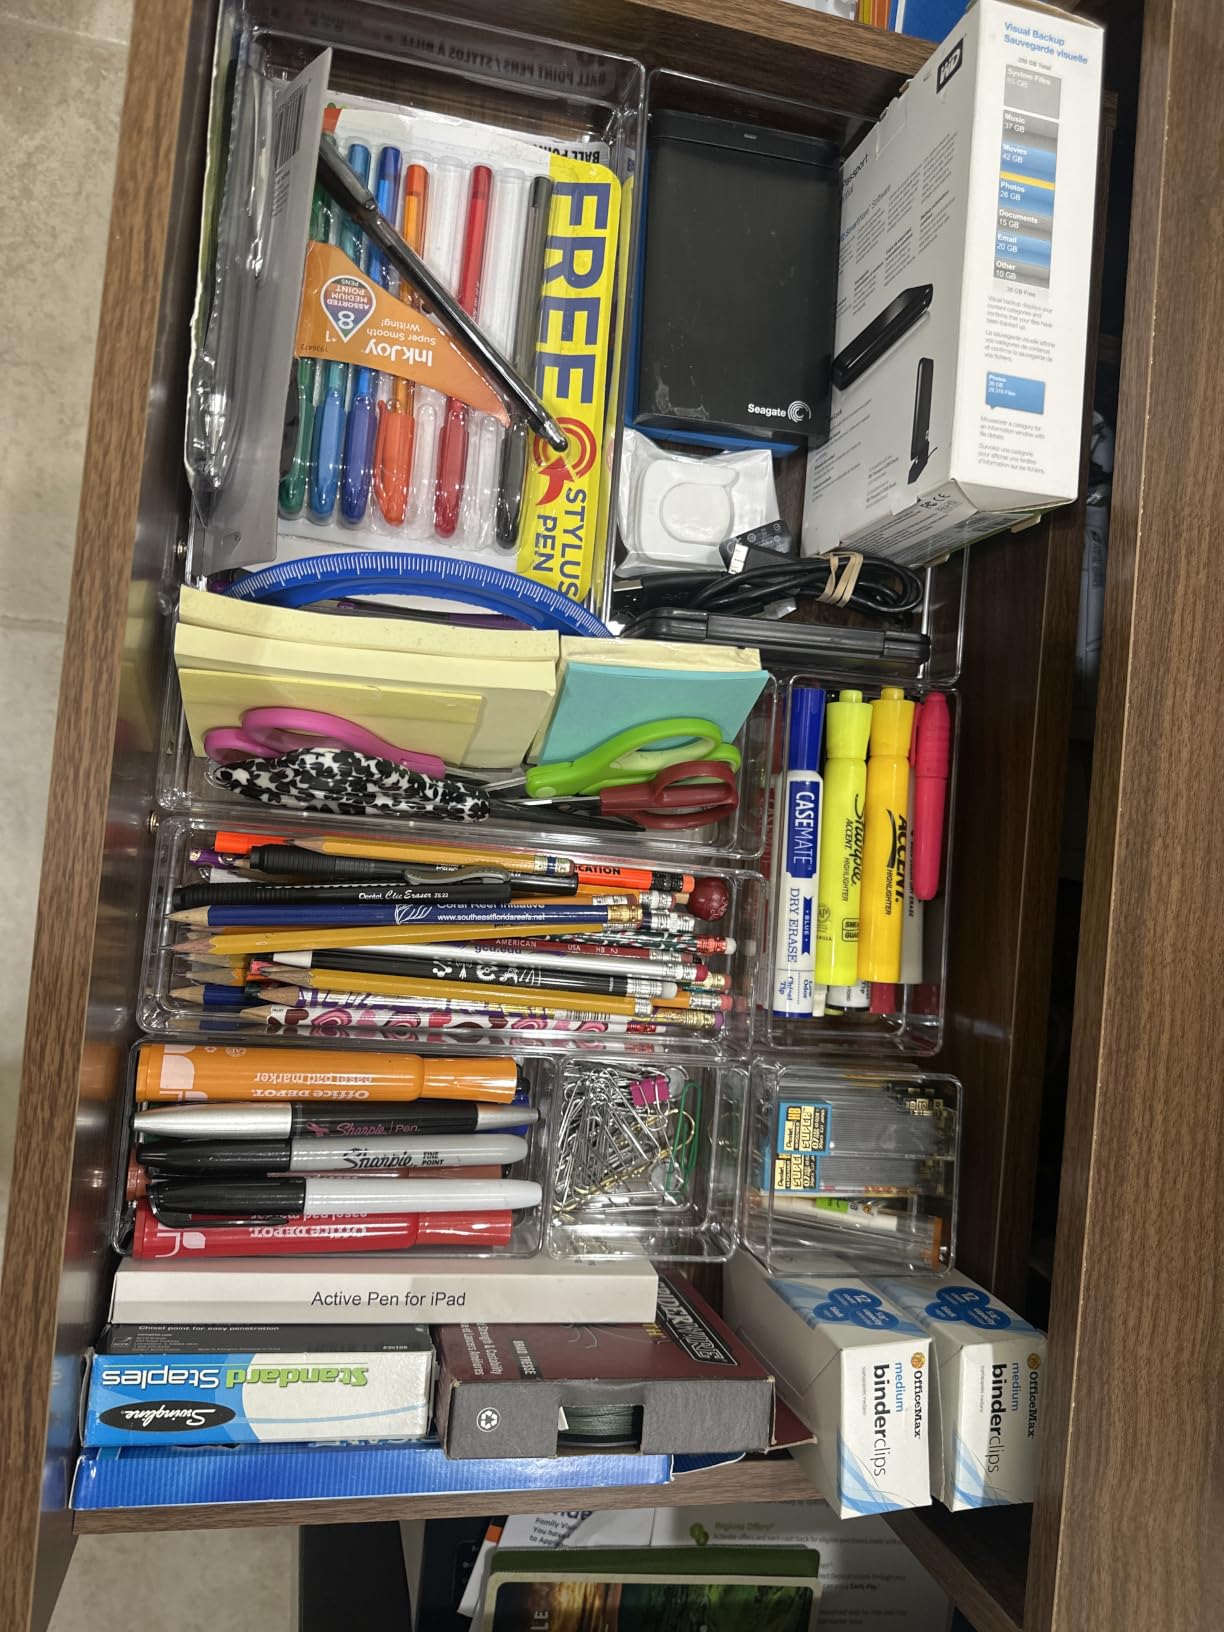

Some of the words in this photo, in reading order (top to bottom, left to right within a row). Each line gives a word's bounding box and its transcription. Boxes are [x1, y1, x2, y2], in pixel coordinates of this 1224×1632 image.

[1005, 22, 1030, 36] Visual
[1032, 30, 1065, 46] Backup
[1004, 34, 1054, 55] Sauvegarde
[1057, 50, 1088, 64] visuelle
[1005, 113, 1025, 124] Music
[1014, 125, 1025, 133] GB
[571, 150, 600, 163] BALL
[1003, 144, 1027, 155] Movies
[1013, 155, 1023, 163] GB
[1001, 181, 1025, 192] Photos
[1011, 193, 1021, 201] GB
[1000, 209, 1038, 224] Documents
[1008, 221, 1019, 229] GB
[998, 233, 1017, 243] Email
[1007, 244, 1018, 252] GB
[996, 260, 1016, 271] Other
[340, 278, 360, 288] PENS
[1006, 271, 1017, 280] GB
[330, 291, 368, 303] MEDIUM
[335, 285, 367, 296] POINT
[535, 182, 612, 404] FREE
[327, 298, 371, 311] ASSORTED
[337, 310, 356, 329] 8
[380, 318, 421, 333] Writing!
[366, 328, 405, 341] Smooth
[407, 334, 437, 347] Super
[364, 339, 434, 367] InkJoy
[747, 403, 787, 417] Seagate
[532, 514, 559, 573] PEN
[557, 488, 587, 598] STYLUS
[794, 790, 815, 865] CASEMATE
[842, 857, 851, 902] HIGHLIGHTER
[885, 869, 894, 915] HIGHLIGHTER
[790, 887, 800, 916] DRY
[496, 938, 537, 948] AMERICAN
[787, 919, 798, 964] ERASE
[779, 981, 787, 995] Tip
[393, 1123, 419, 1133] Pen
[801, 1112, 812, 1149] SUPER
[343, 1148, 414, 1168] Sharpie
[423, 1151, 439, 1159] FINE
[792, 1153, 802, 1187] SUPE
[310, 1291, 362, 1306] Active
[367, 1291, 399, 1306] Pen
[404, 1291, 426, 1306] for
[430, 1291, 466, 1306] iPad
[101, 1365, 221, 1390] Staples
[226, 1367, 369, 1389] Standard
[895, 1362, 906, 1413] medium
[1011, 1362, 1022, 1412] medium
[914, 1370, 923, 1438] OfficeMax
[1027, 1371, 1039, 1437] OfficeMax
[124, 1404, 217, 1427] Swingline
[870, 1363, 891, 1477] binderclips
[985, 1363, 1007, 1473] binderclips
